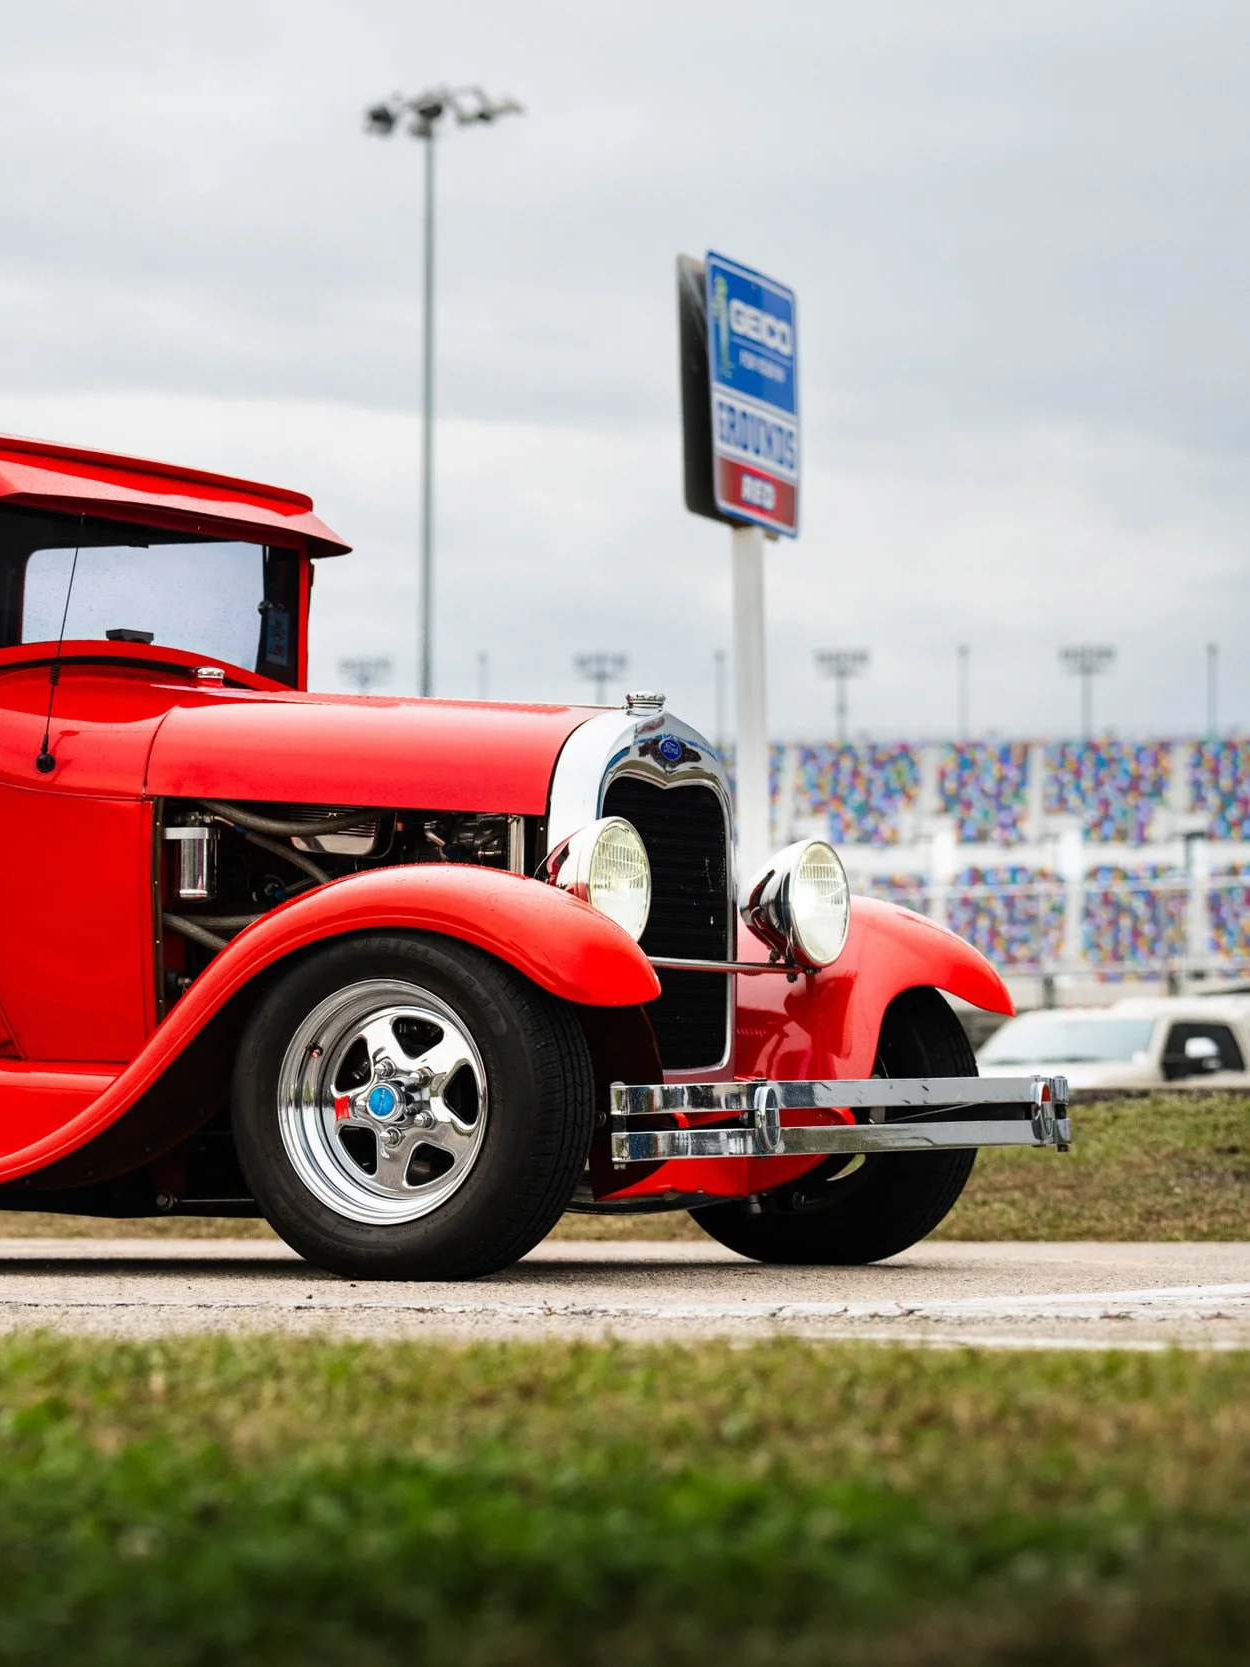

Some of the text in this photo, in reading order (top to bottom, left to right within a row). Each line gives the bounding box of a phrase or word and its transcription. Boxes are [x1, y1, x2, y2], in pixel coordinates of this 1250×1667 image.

[729, 298, 792, 357] GEICO
[717, 401, 795, 470] GROUNDS
[663, 741, 679, 755] Ford
